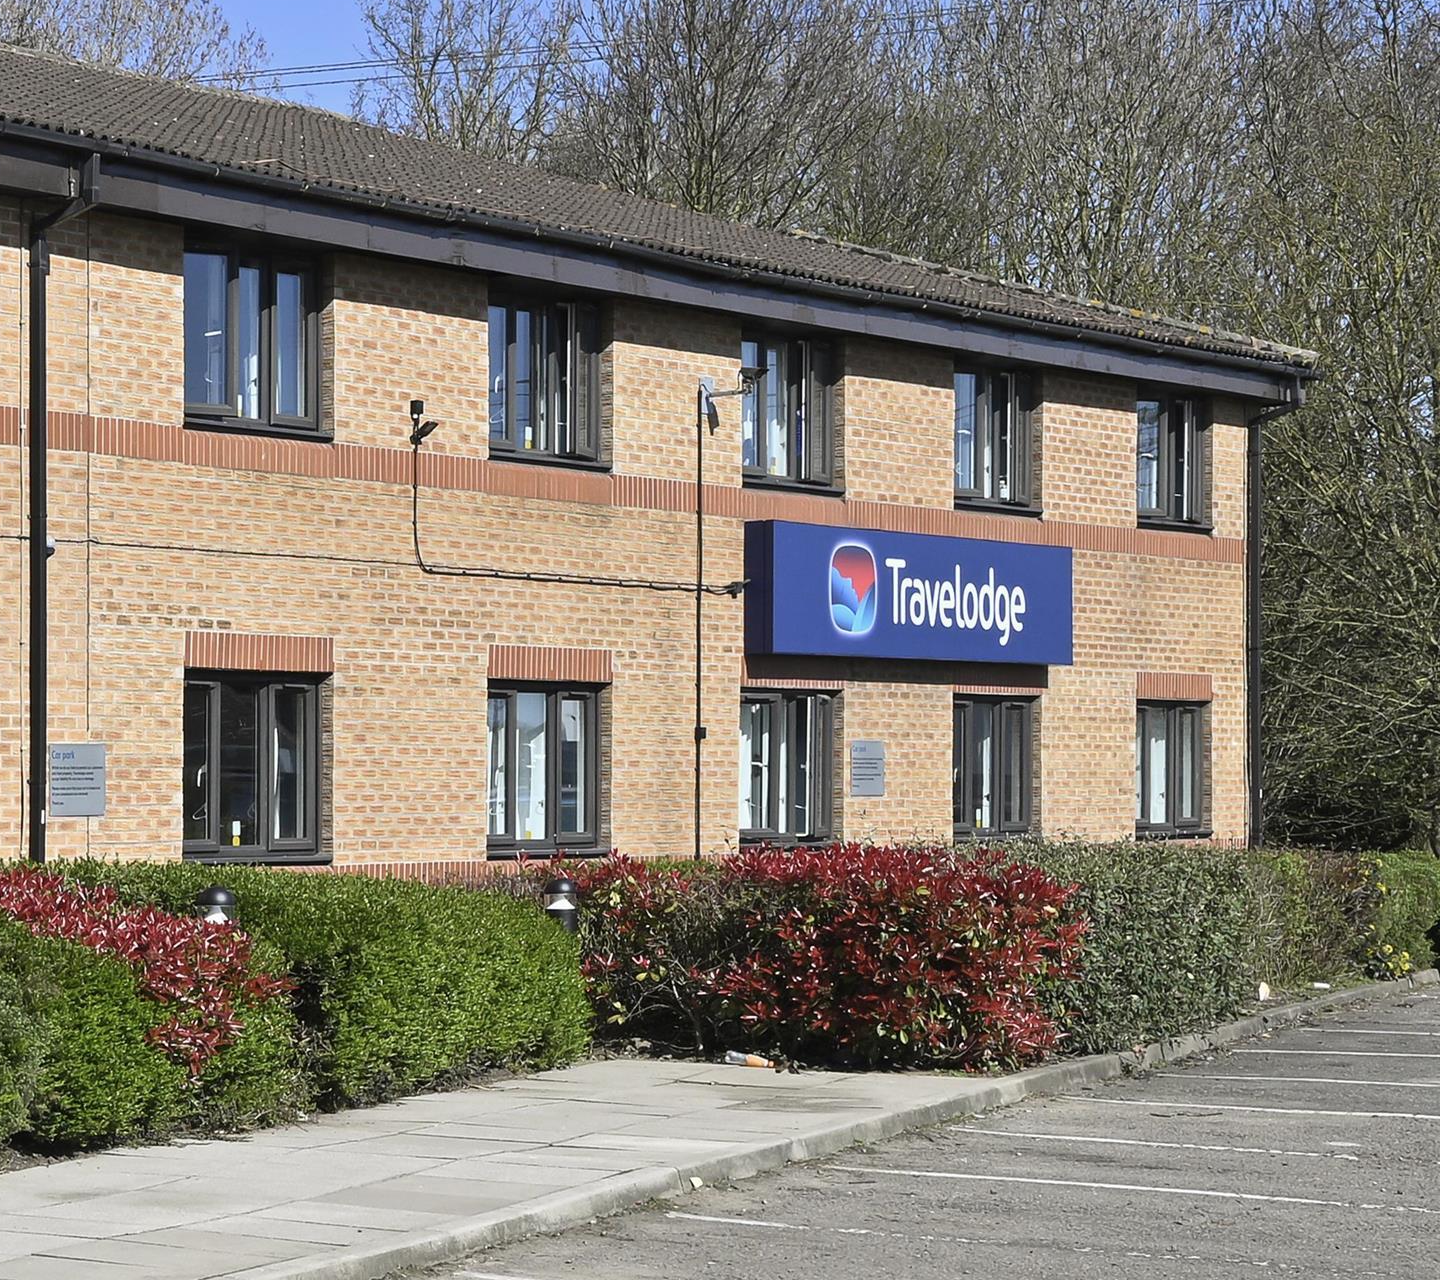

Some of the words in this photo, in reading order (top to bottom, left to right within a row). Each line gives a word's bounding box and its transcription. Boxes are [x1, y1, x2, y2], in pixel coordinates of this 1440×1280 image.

[885, 558, 1026, 646] Travelodge
[52, 750, 61, 760] Car
[62, 750, 75, 761] park
